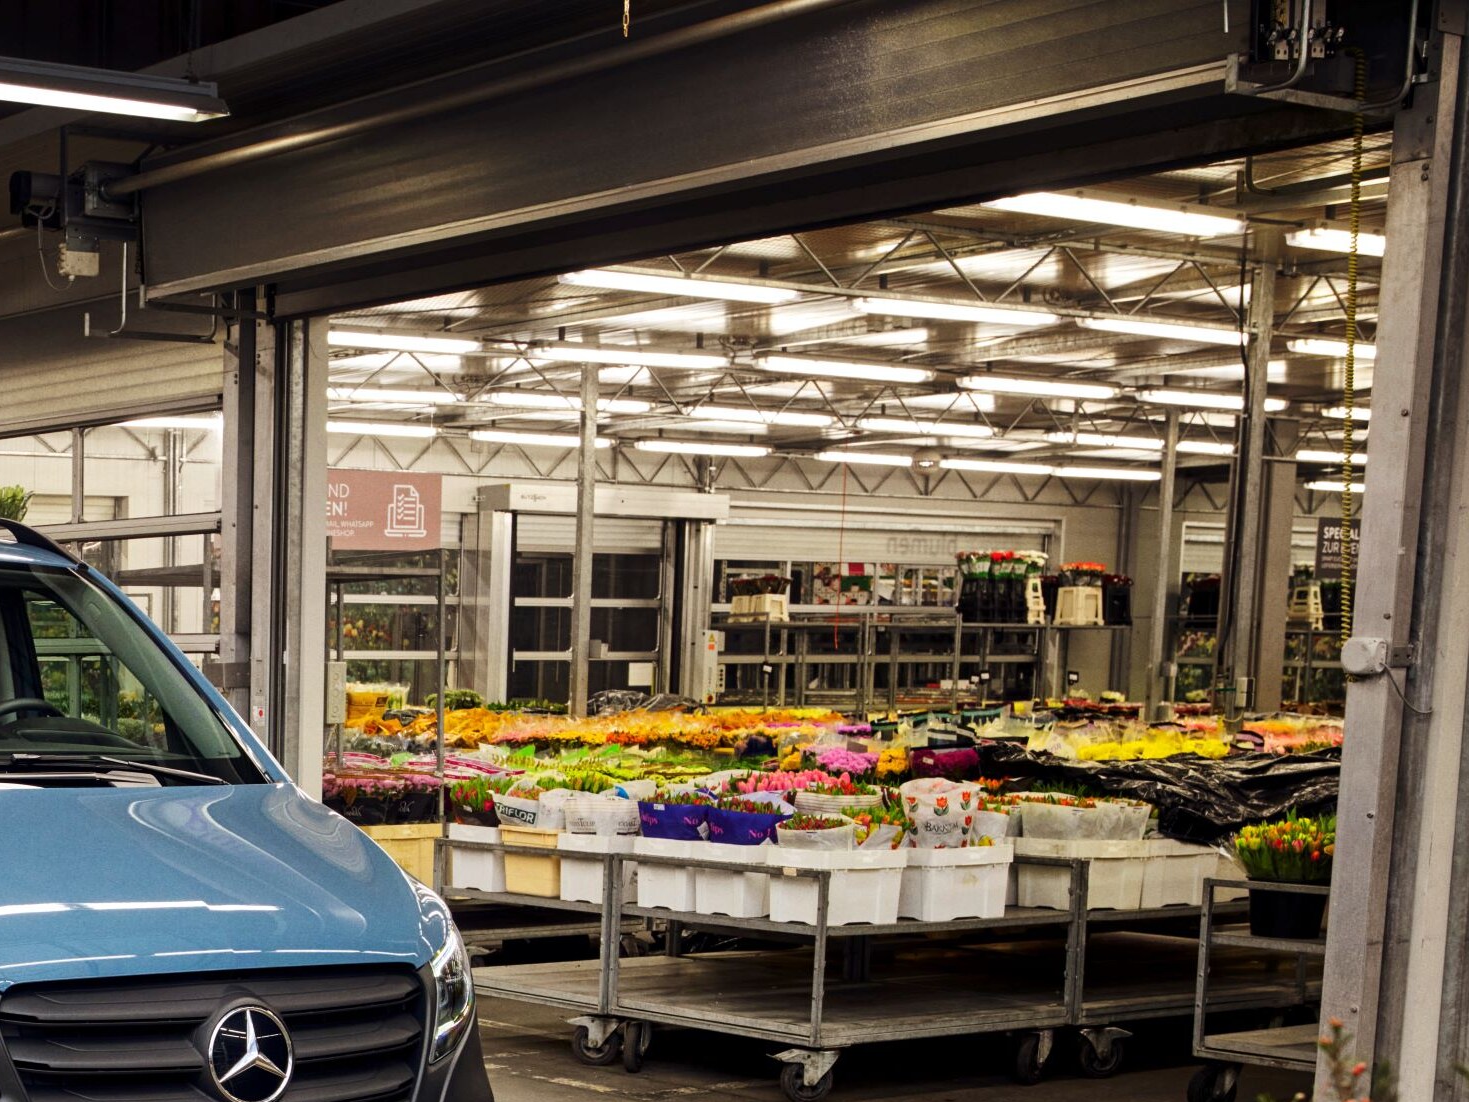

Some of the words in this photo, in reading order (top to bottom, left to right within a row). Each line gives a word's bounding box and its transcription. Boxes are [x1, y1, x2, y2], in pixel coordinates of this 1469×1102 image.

[328, 483, 350, 498] ND
[325, 501, 348, 516] EN!
[1323, 526, 1360, 541] SPECAL
[1321, 541, 1340, 554] ZUR
[496, 803, 534, 823] TRIFLOR
[709, 821, 724, 835] lips
